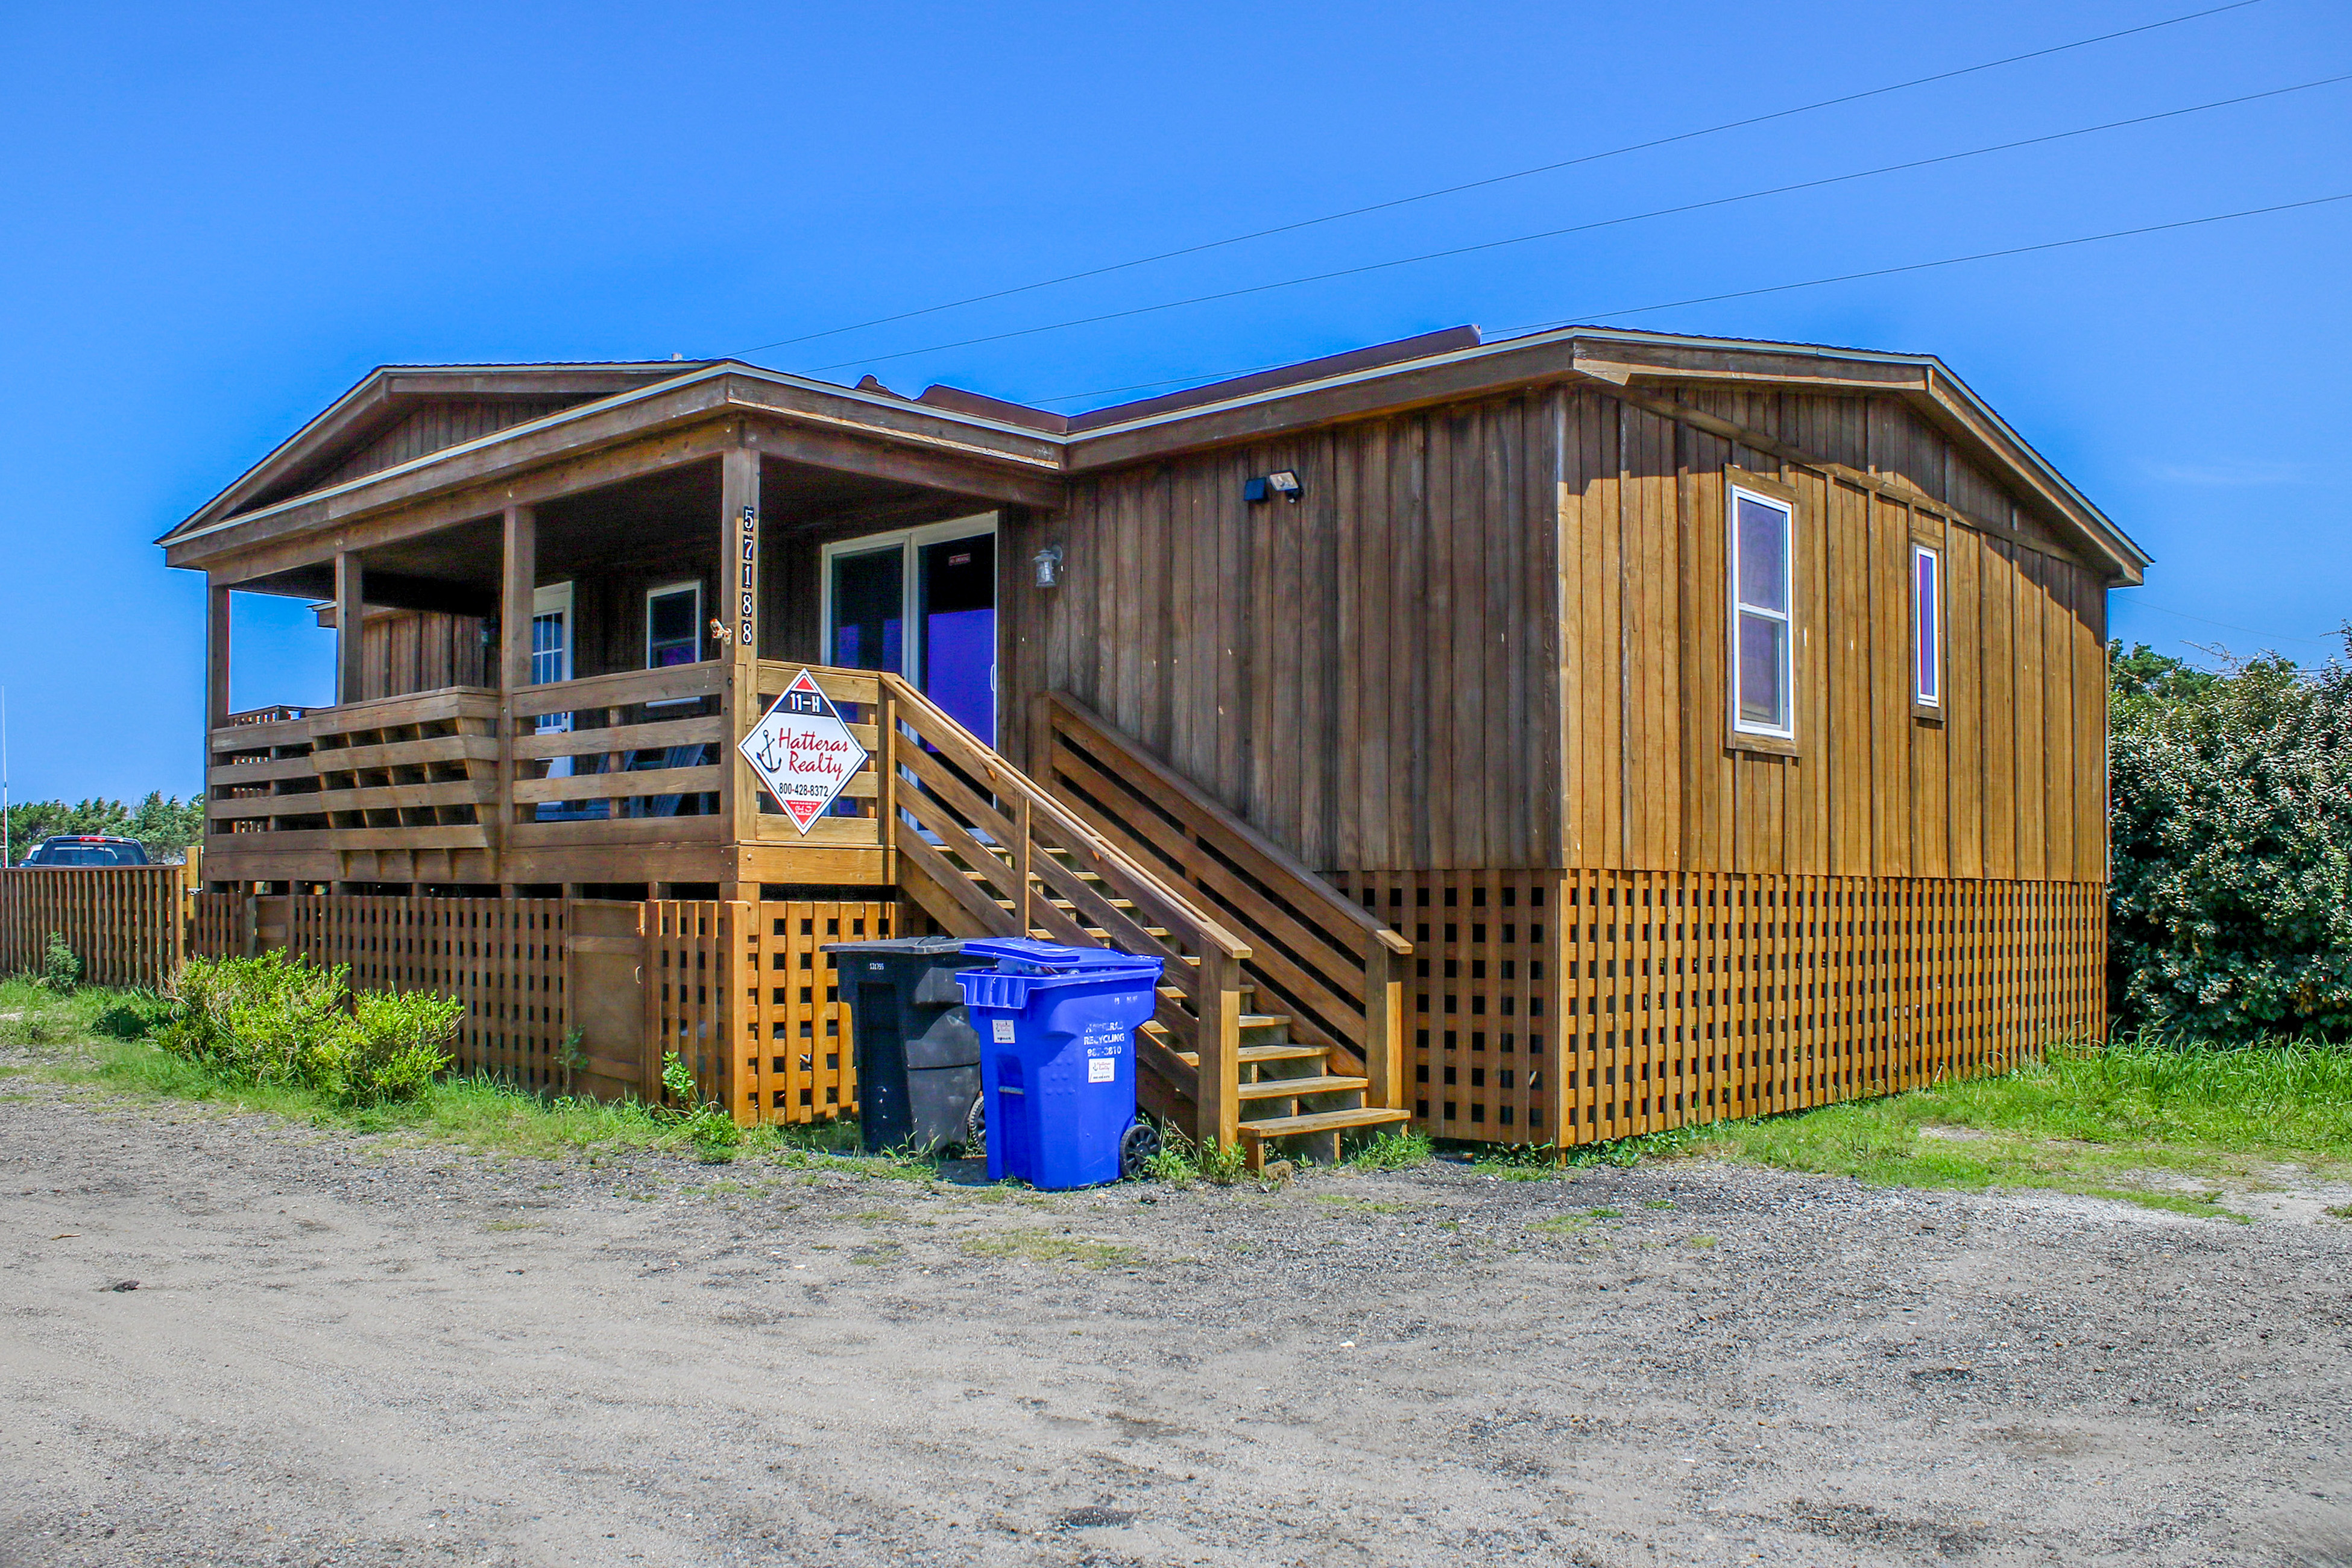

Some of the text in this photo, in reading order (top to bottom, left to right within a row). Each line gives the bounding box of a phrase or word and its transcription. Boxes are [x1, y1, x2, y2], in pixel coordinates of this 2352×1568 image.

[742, 509, 754, 643] 57188
[790, 693, 821, 713] 11-H
[778, 727, 848, 753] Hatteras
[789, 750, 843, 782] Realty
[1083, 1033, 1125, 1045] RECYCLING
